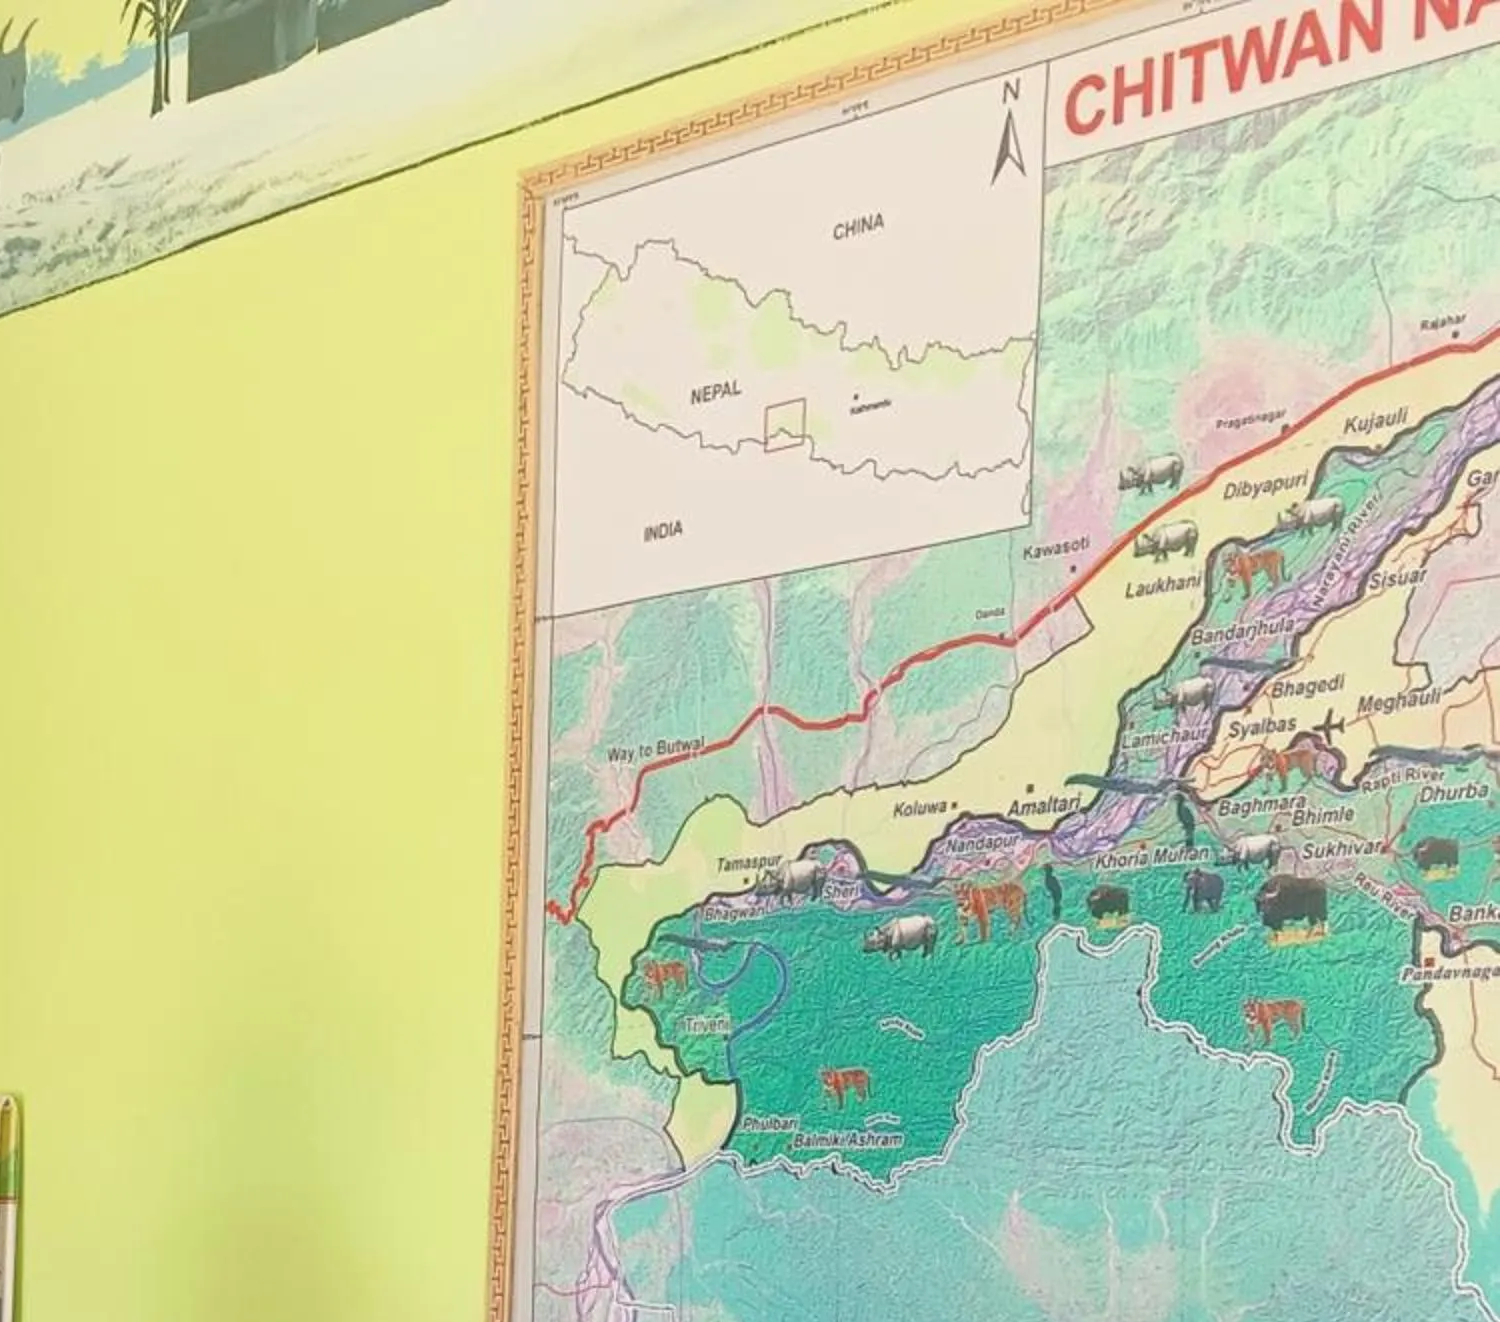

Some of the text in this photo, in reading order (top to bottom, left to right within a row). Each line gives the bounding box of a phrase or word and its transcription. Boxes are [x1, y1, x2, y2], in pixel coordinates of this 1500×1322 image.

[1065, 0, 1382, 136] CHITWAN
[1003, 78, 1020, 103] N
[833, 211, 885, 240] CHINA
[1420, 312, 1467, 331] Rajahar
[691, 379, 742, 404] NEPAL
[1343, 406, 1409, 435] Kujauli
[1223, 468, 1309, 504] Dibyapuri
[643, 519, 683, 543] INDIA
[1023, 535, 1091, 561] Kawasoti
[1125, 569, 1202, 600] Laukhani
[1312, 538, 1350, 607] Narayani
[1369, 567, 1428, 590] Sisuar
[1191, 616, 1295, 646] Bandarjhula
[1271, 673, 1345, 699] Bhagedi
[1357, 688, 1443, 715] Meghauli
[1122, 728, 1208, 750] Lamichaur
[1228, 717, 1297, 739] Syalbas
[607, 735, 705, 764] Way to Butwal
[1405, 766, 1445, 782] River
[1008, 792, 1082, 817] Amaltari
[1419, 783, 1489, 803] Dhurba
[893, 800, 947, 818] Koluwa
[1218, 794, 1307, 818] Baghmara
[1292, 806, 1355, 827] Bhimle
[947, 834, 1020, 853] Nandapur
[717, 854, 783, 874] Tamaspur
[823, 884, 861, 899] Sheri
[846, 1132, 903, 1147] Ashram
